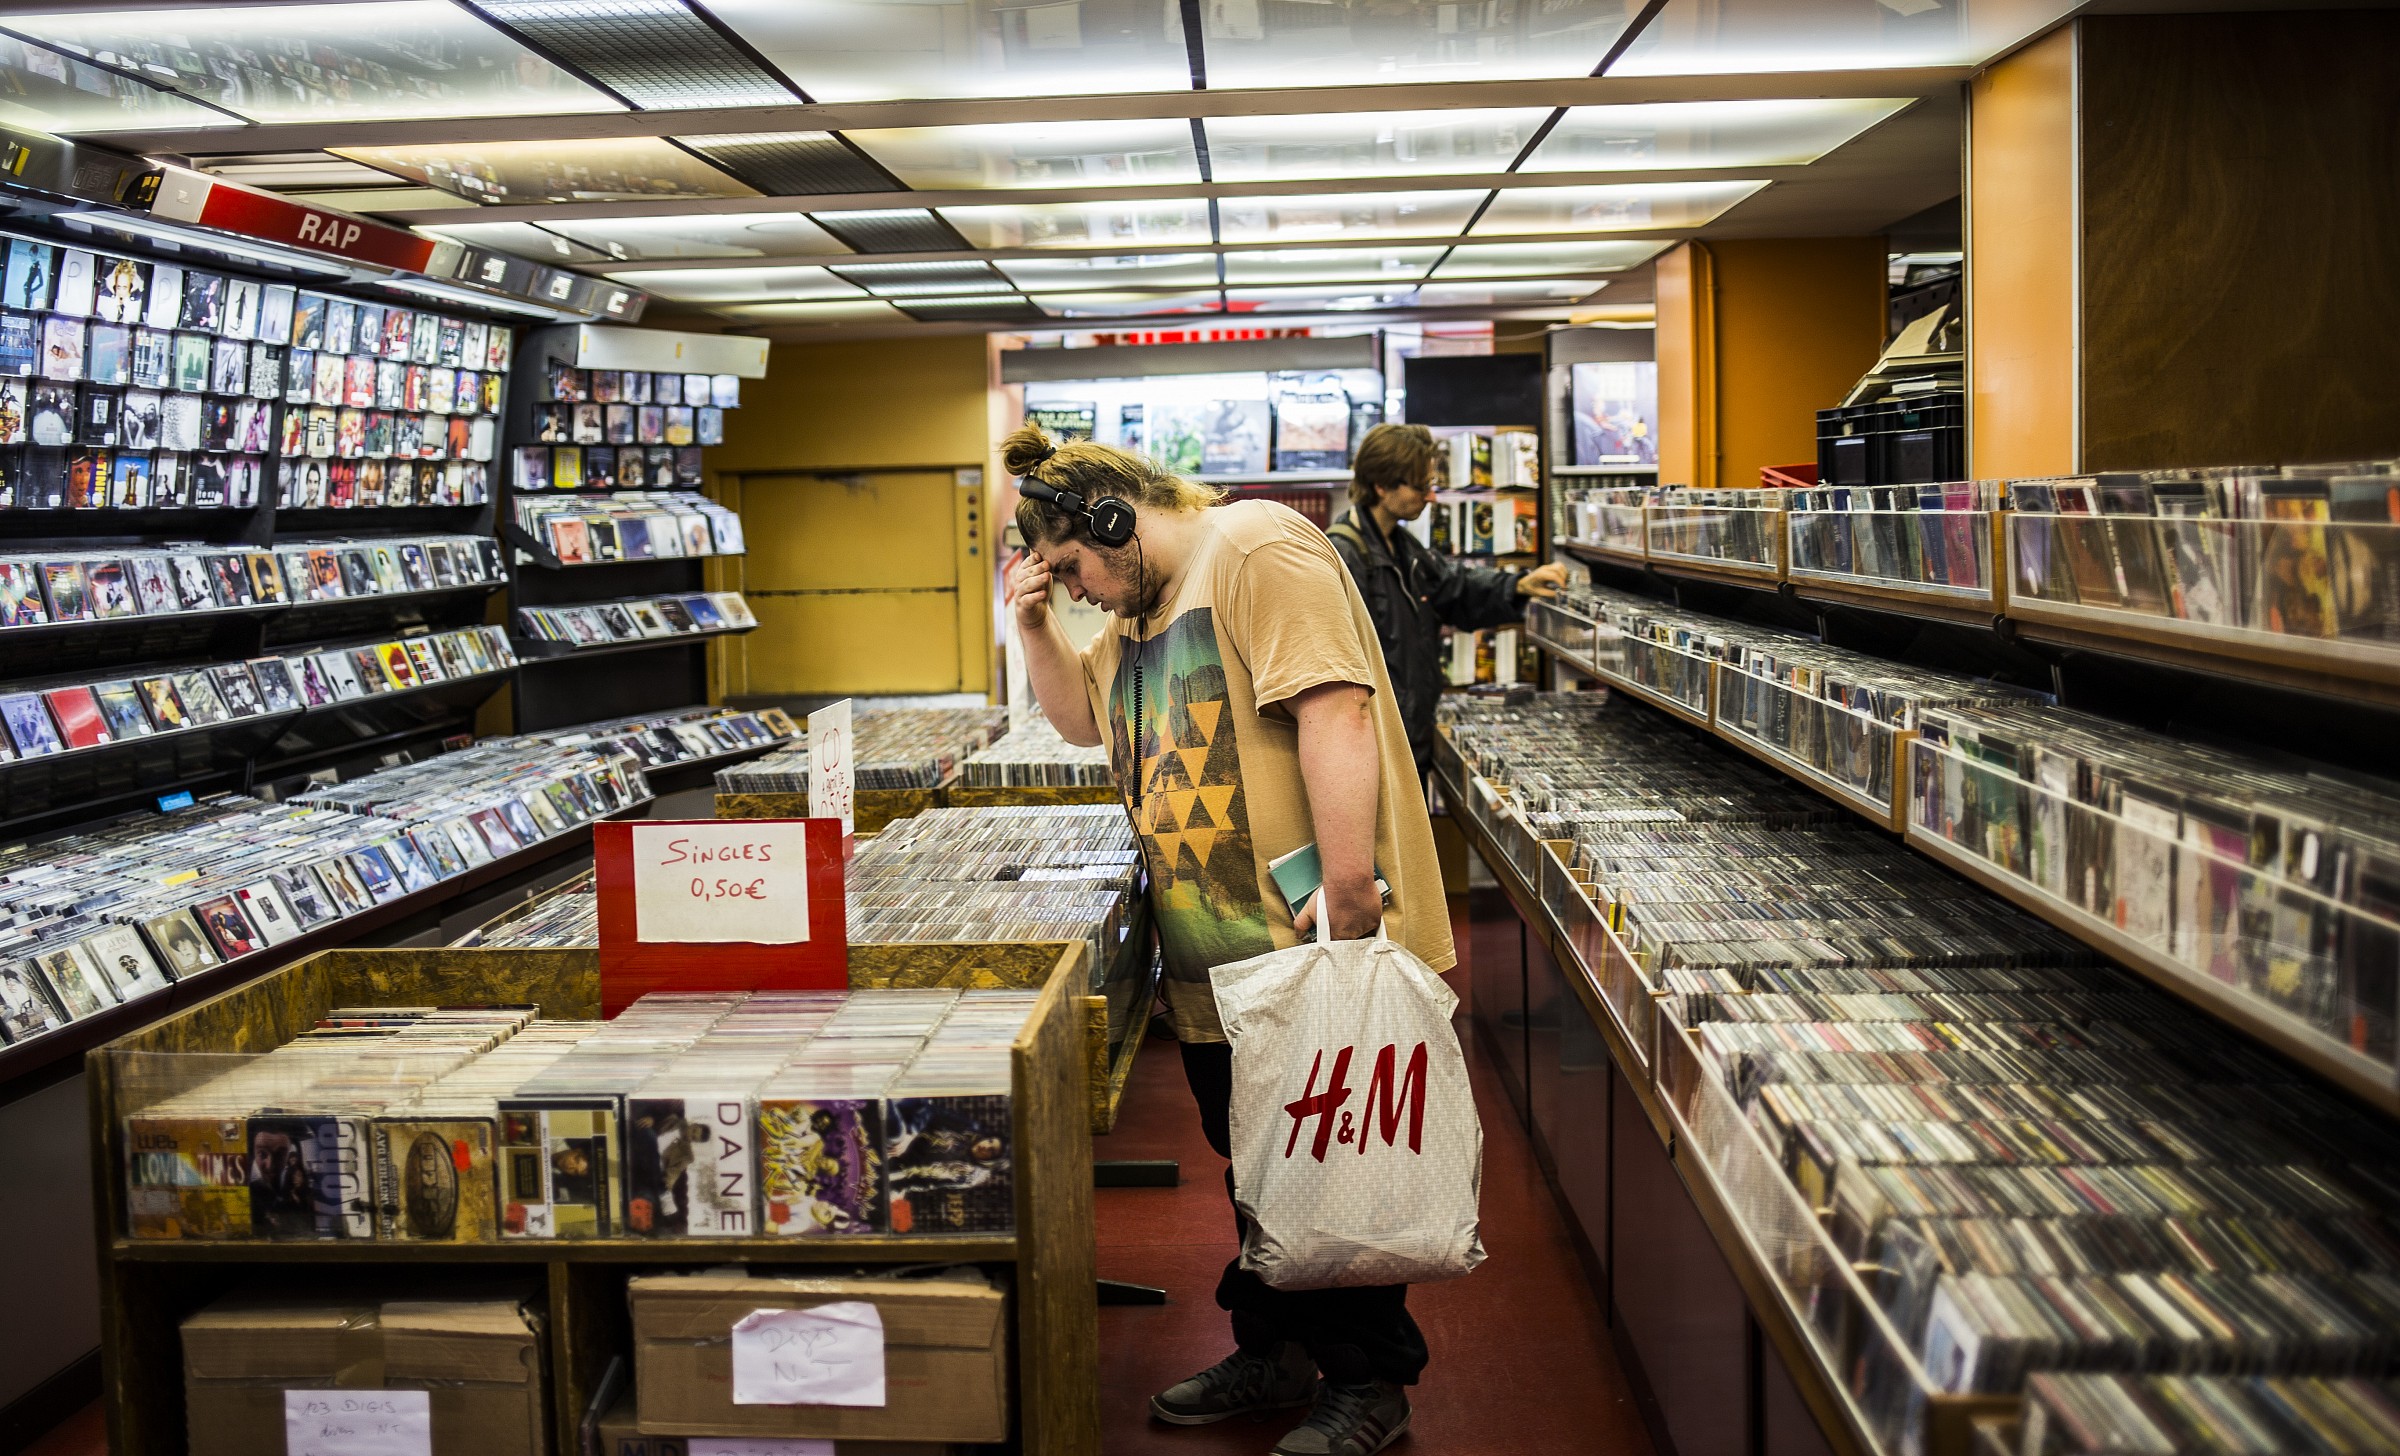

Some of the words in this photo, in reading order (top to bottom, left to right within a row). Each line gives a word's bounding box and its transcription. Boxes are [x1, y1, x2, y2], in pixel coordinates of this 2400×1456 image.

[297, 211, 363, 250] RAP
[822, 727, 842, 773] CD
[690, 877, 767, 903] 0,50€
[1284, 1040, 1429, 1164] H&M
[375, 1132, 387, 1155] DAY
[717, 1102, 745, 1232] DANE
